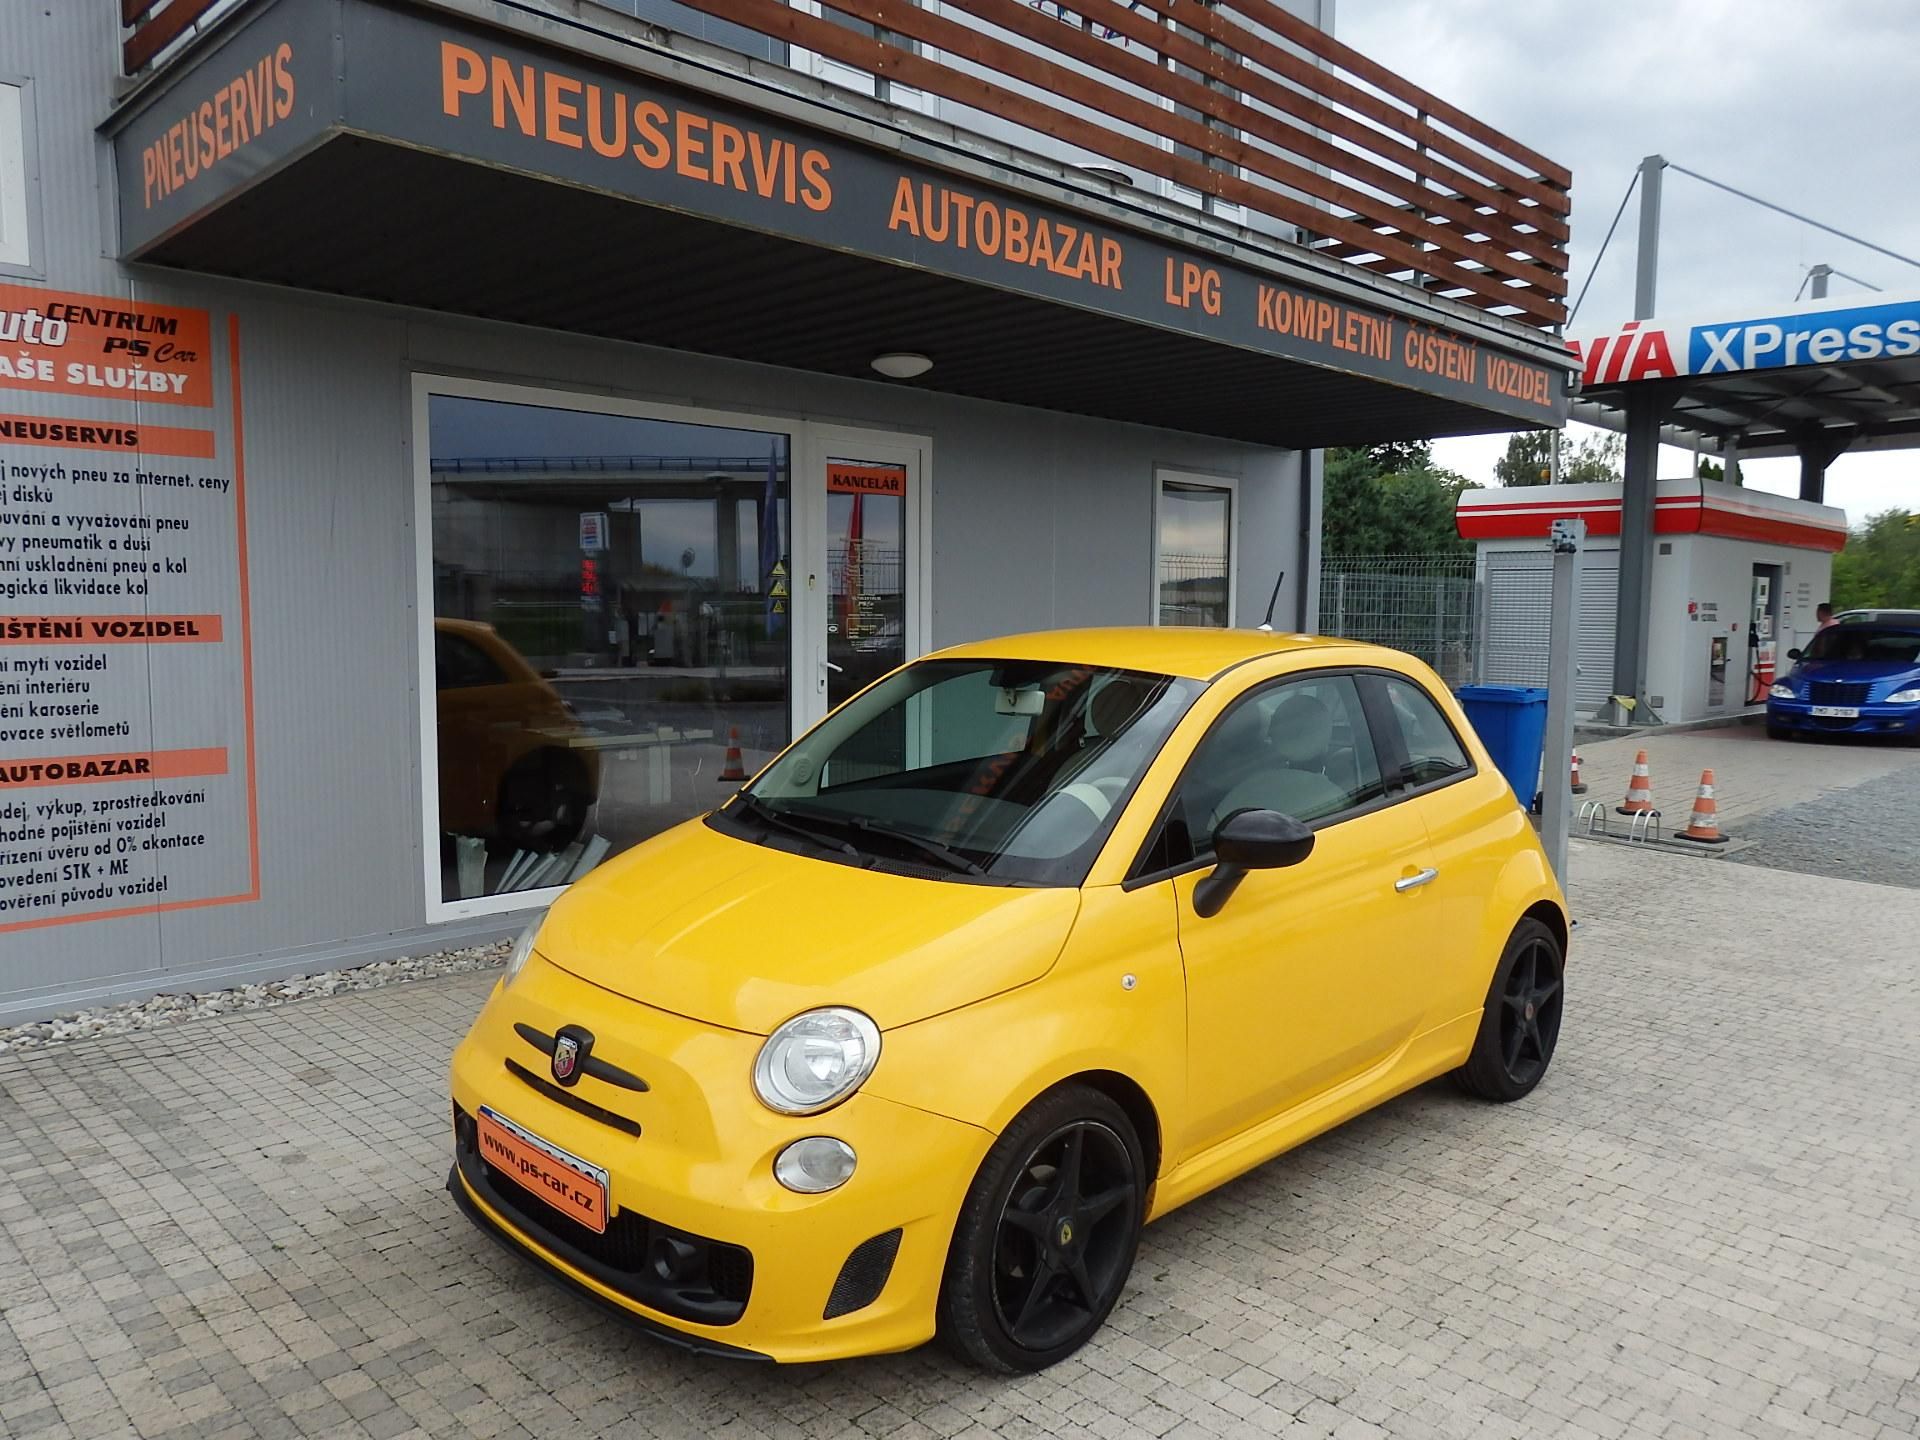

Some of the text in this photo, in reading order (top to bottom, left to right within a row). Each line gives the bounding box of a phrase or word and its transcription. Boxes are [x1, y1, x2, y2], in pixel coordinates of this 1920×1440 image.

[143, 42, 295, 209] PNEUSERVIS
[440, 41, 1552, 408] PNEUSERVIS AUTOBAZAR LPG KOMPLETNÍ ČIŠTĚNÍ VOZIDEL
[47, 302, 178, 336] CENTRUM
[103, 337, 198, 364] PS Car
[66, 363, 189, 395] SLUŽBY
[11, 463, 66, 483] nových
[72, 469, 108, 485] pneu
[113, 471, 130, 484] za
[135, 468, 194, 488] internet.
[198, 477, 230, 493] ceny
[832, 474, 899, 491] KANCELÁŘ
[13, 484, 53, 503] disků
[51, 515, 60, 526] a
[66, 512, 151, 532] vyvažování
[156, 518, 189, 534] pneu
[22, 532, 103, 553] pneumatik
[108, 540, 117, 550] a
[25, 554, 108, 573] uskladnění
[113, 561, 147, 577] pneu
[152, 562, 161, 574] a
[166, 556, 187, 574] kol
[54, 577, 121, 596] likvidace
[126, 577, 148, 596] kol
[91, 620, 200, 638] VOZIDEL
[54, 653, 107, 671] vozidel
[25, 676, 90, 694] interiéru
[28, 698, 100, 717] karoserie
[50, 720, 130, 739] světlometů
[0, 758, 150, 783] AUTOBAZAR
[36, 798, 87, 820] výkup,
[92, 788, 206, 815] zprostředkování
[51, 817, 111, 842] pojištění
[116, 811, 166, 831] vozidel
[94, 837, 111, 856] od
[116, 835, 138, 853] 0%
[142, 833, 205, 851] akontace
[63, 862, 92, 881] STK
[109, 858, 129, 876] ME
[61, 882, 113, 908] původu
[118, 875, 168, 897] vozidel
[483, 1131, 595, 1213] www.ps-car.cz
